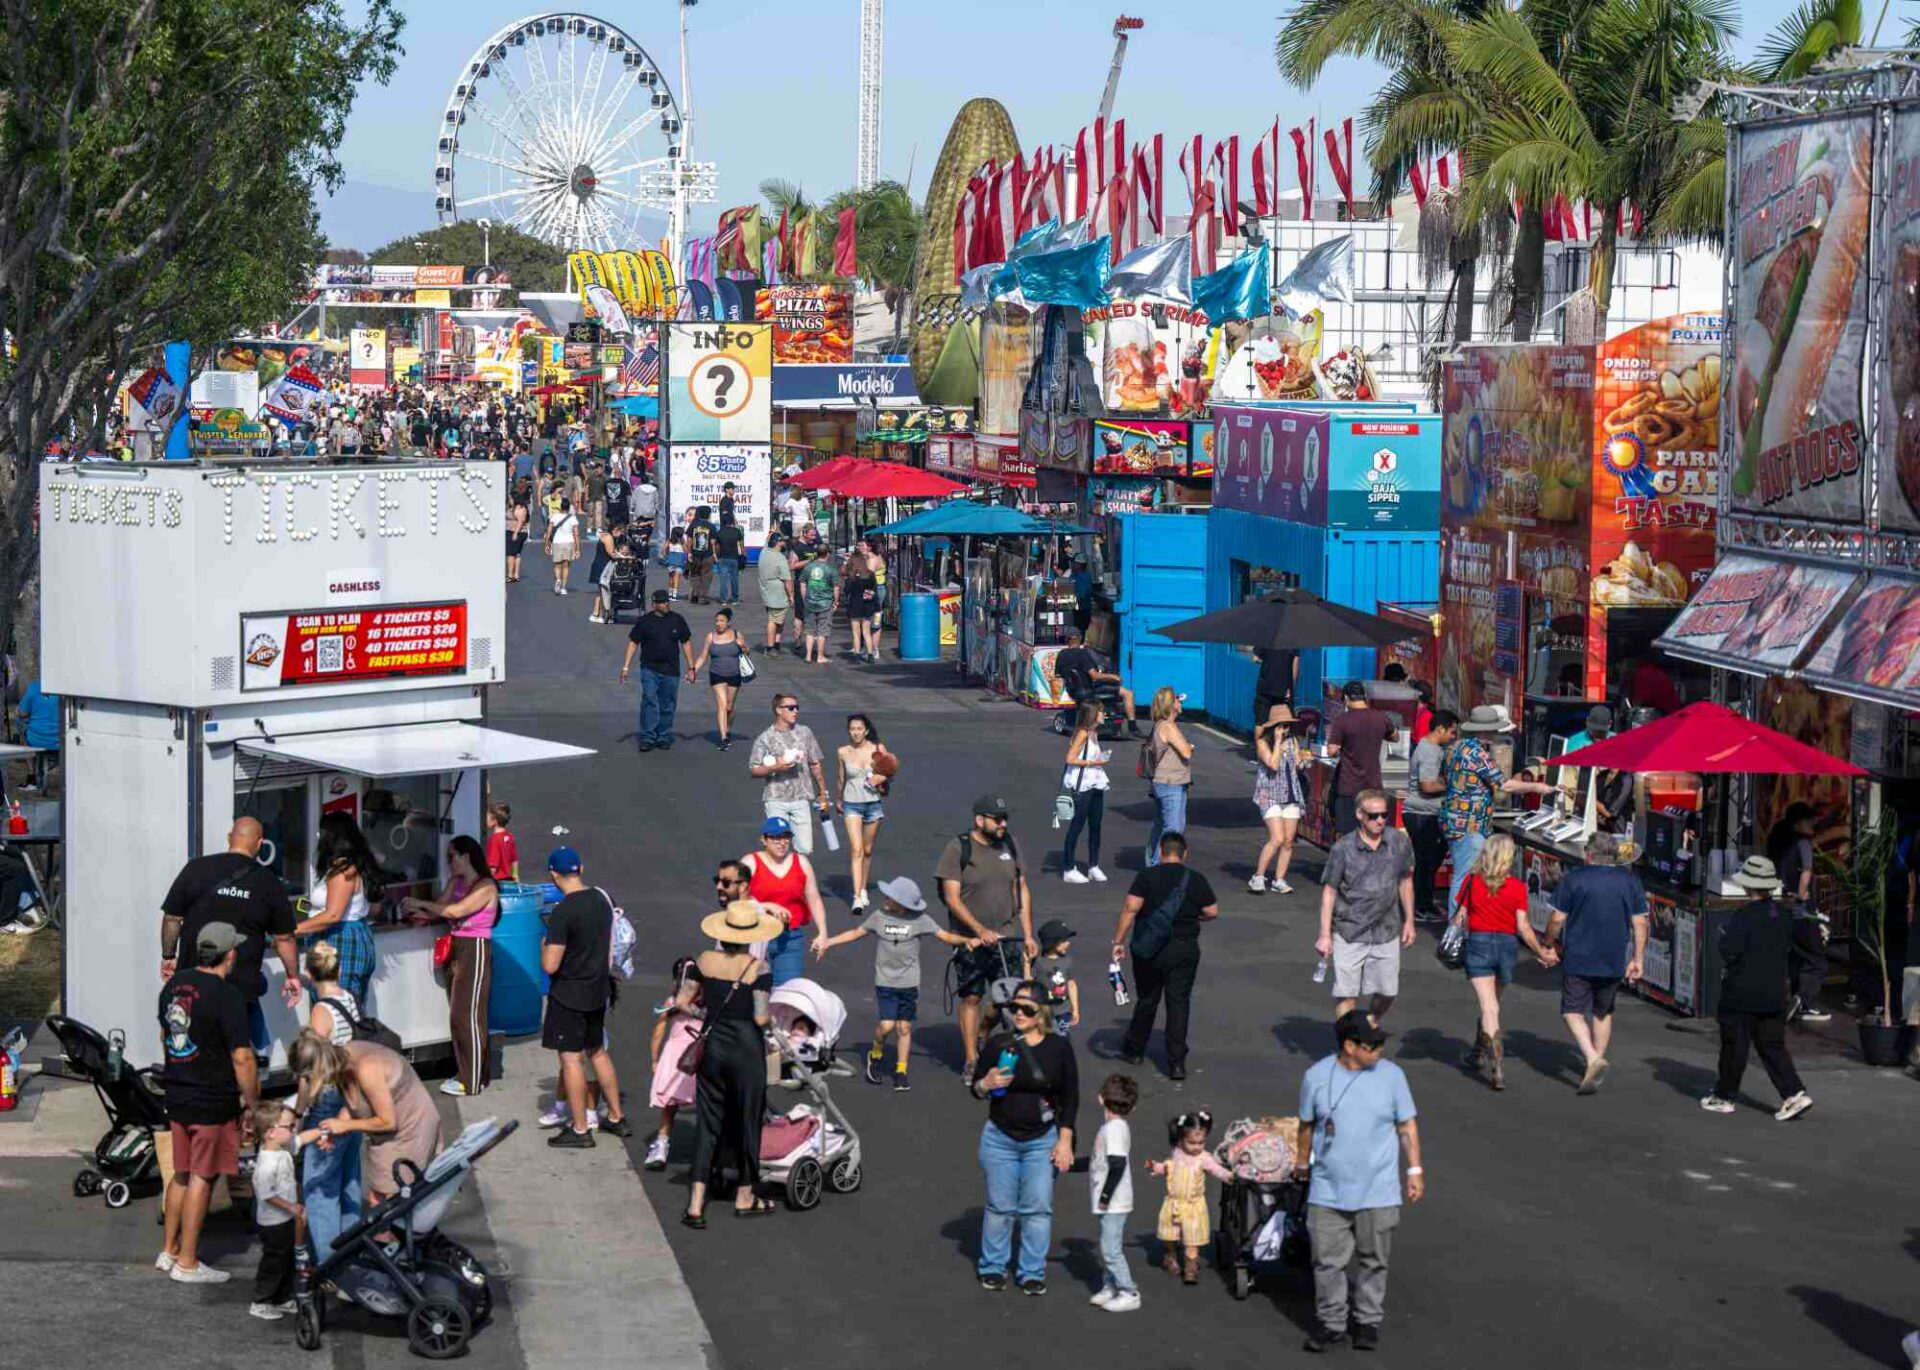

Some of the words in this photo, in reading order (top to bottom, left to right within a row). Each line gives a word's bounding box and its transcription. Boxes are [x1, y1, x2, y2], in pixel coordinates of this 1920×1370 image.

[419, 267, 447, 276] Guest
[775, 298, 825, 312] PIZZA
[1141, 301, 1210, 327] SRIMP
[780, 316, 824, 330] WINGS
[693, 330, 754, 349] INFO
[1603, 357, 1650, 369] ONION
[1614, 370, 1657, 380] RINGS
[838, 373, 895, 394] Modelo
[698, 455, 720, 472] $5
[1758, 444, 1793, 502] HOT
[1792, 418, 1861, 491] DOGS
[691, 485, 714, 493] TREAT
[1107, 489, 1139, 499] PARTY
[1373, 485, 1396, 493] BAJA
[50, 483, 182, 527] TICKETS
[1368, 494, 1399, 503] SIPPER
[210, 469, 493, 545] TICKETS
[330, 581, 380, 593] CASHLESS
[297, 616, 321, 627] SCAN
[324, 616, 335, 625] TO
[338, 614, 360, 624] PLAN
[374, 613, 382, 623] 4
[384, 611, 430, 622] TICKETS
[433, 609, 449, 621] $5
[368, 629, 381, 639] 16
[384, 627, 430, 638] TICKETS
[433, 625, 456, 636] $20
[365, 644, 382, 654] 40
[384, 642, 431, 652] TICKETS
[433, 639, 457, 650] $50
[369, 655, 426, 667] FASTPASS
[429, 651, 453, 663] $30
